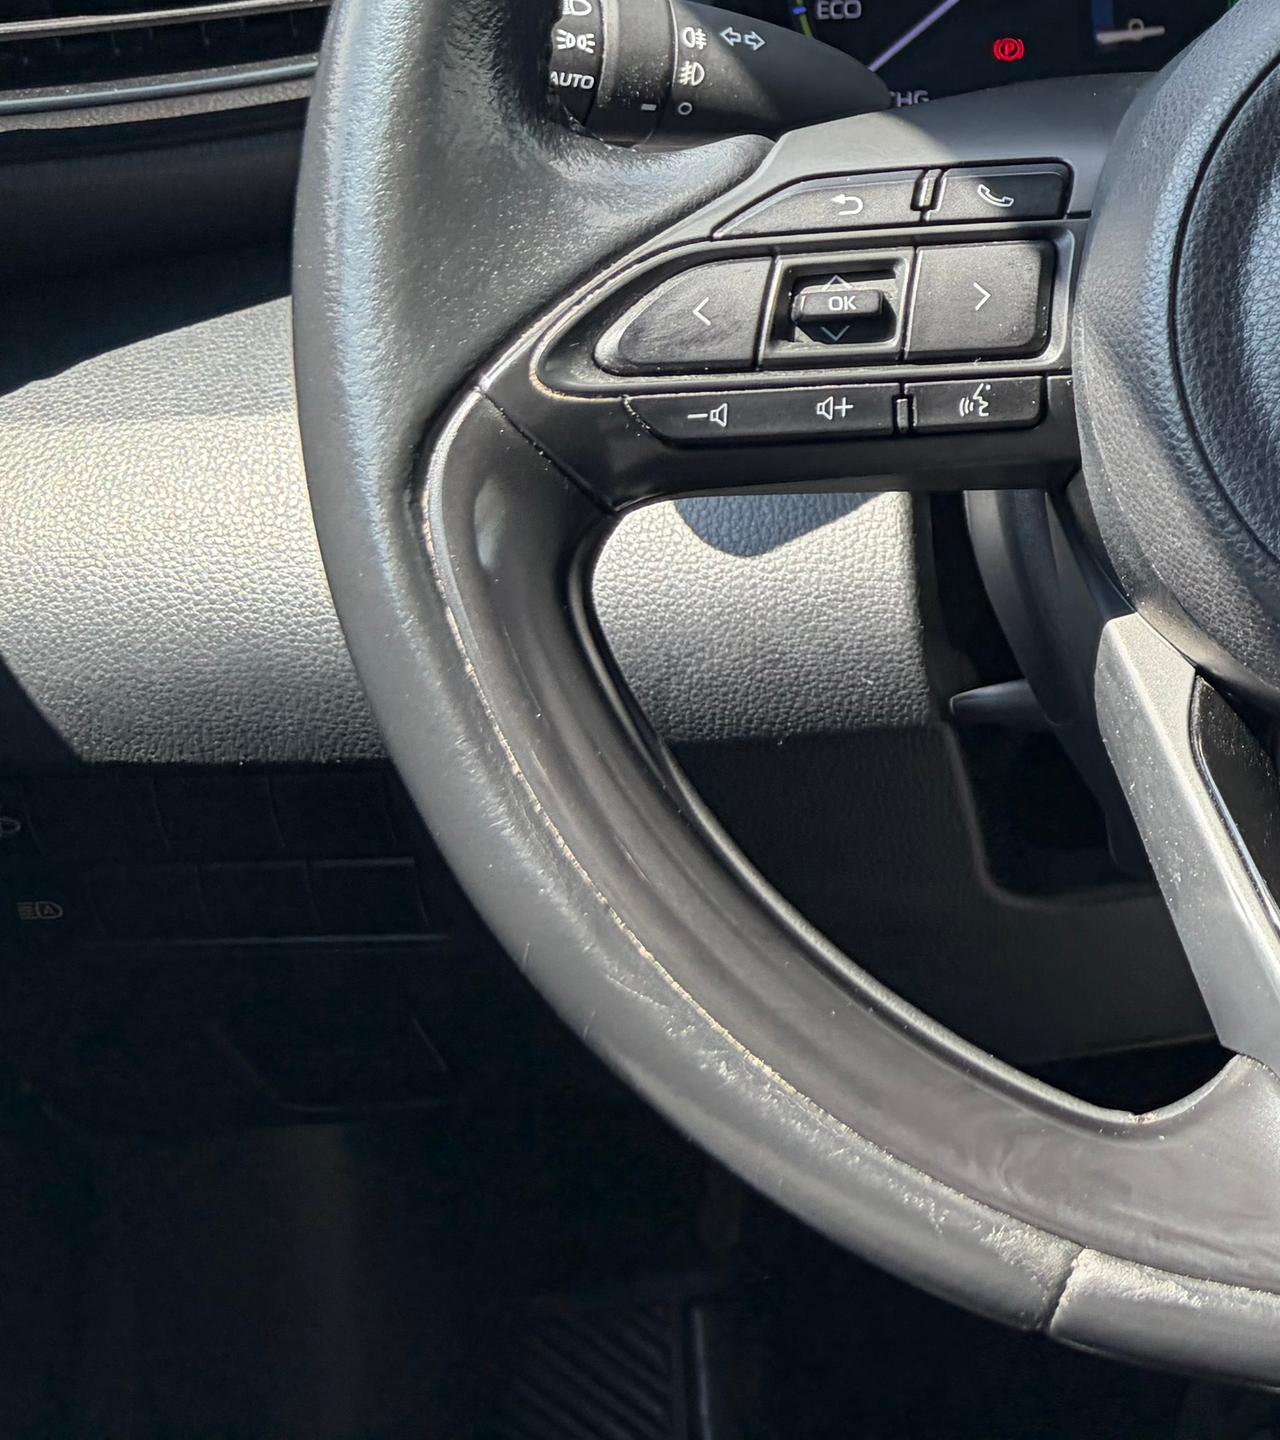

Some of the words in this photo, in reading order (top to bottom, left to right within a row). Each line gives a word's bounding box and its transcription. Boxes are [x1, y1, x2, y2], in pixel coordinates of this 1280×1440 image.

[816, 0, 862, 19] ECO
[551, 71, 594, 89] AUTO
[889, 90, 929, 107] HG
[828, 295, 857, 311] OK
